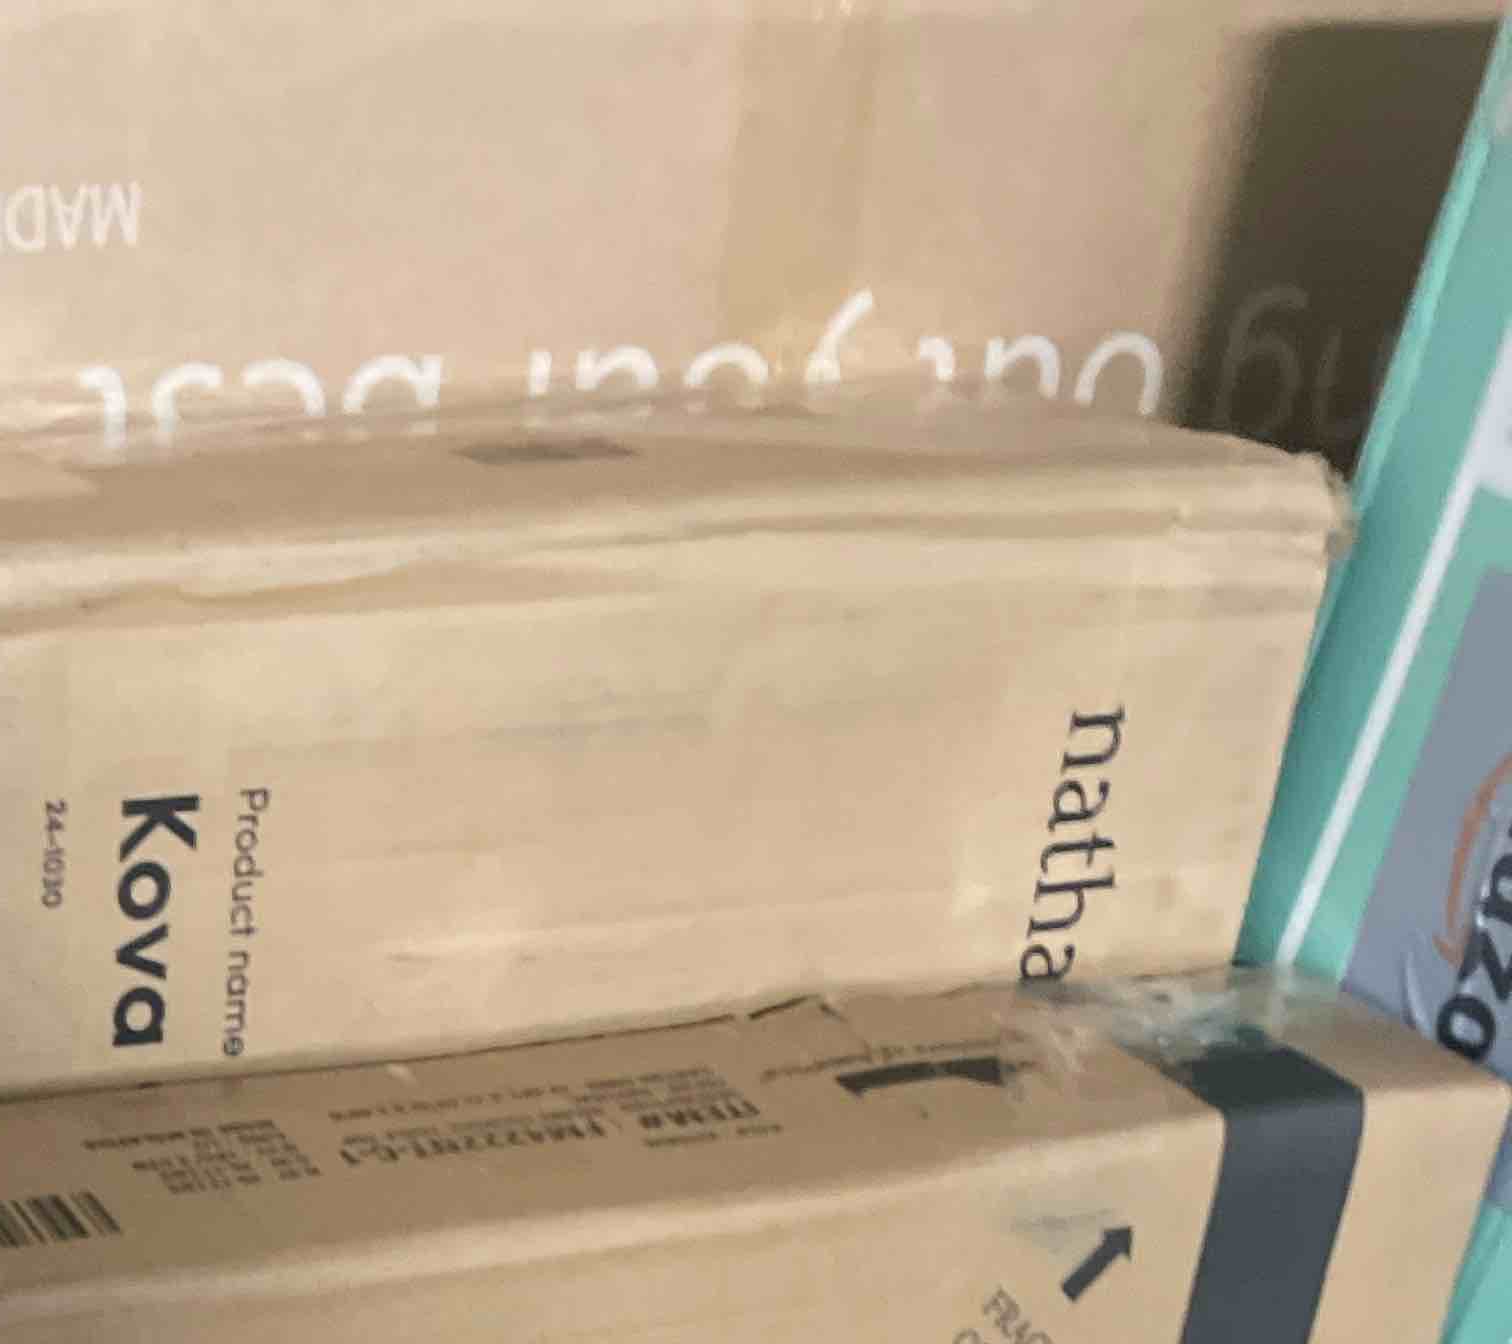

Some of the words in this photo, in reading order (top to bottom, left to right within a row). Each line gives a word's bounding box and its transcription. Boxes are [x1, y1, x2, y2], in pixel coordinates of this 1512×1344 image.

[113, 794, 200, 1048] Kova
[227, 787, 270, 937] Product
[222, 948, 258, 1058] name
